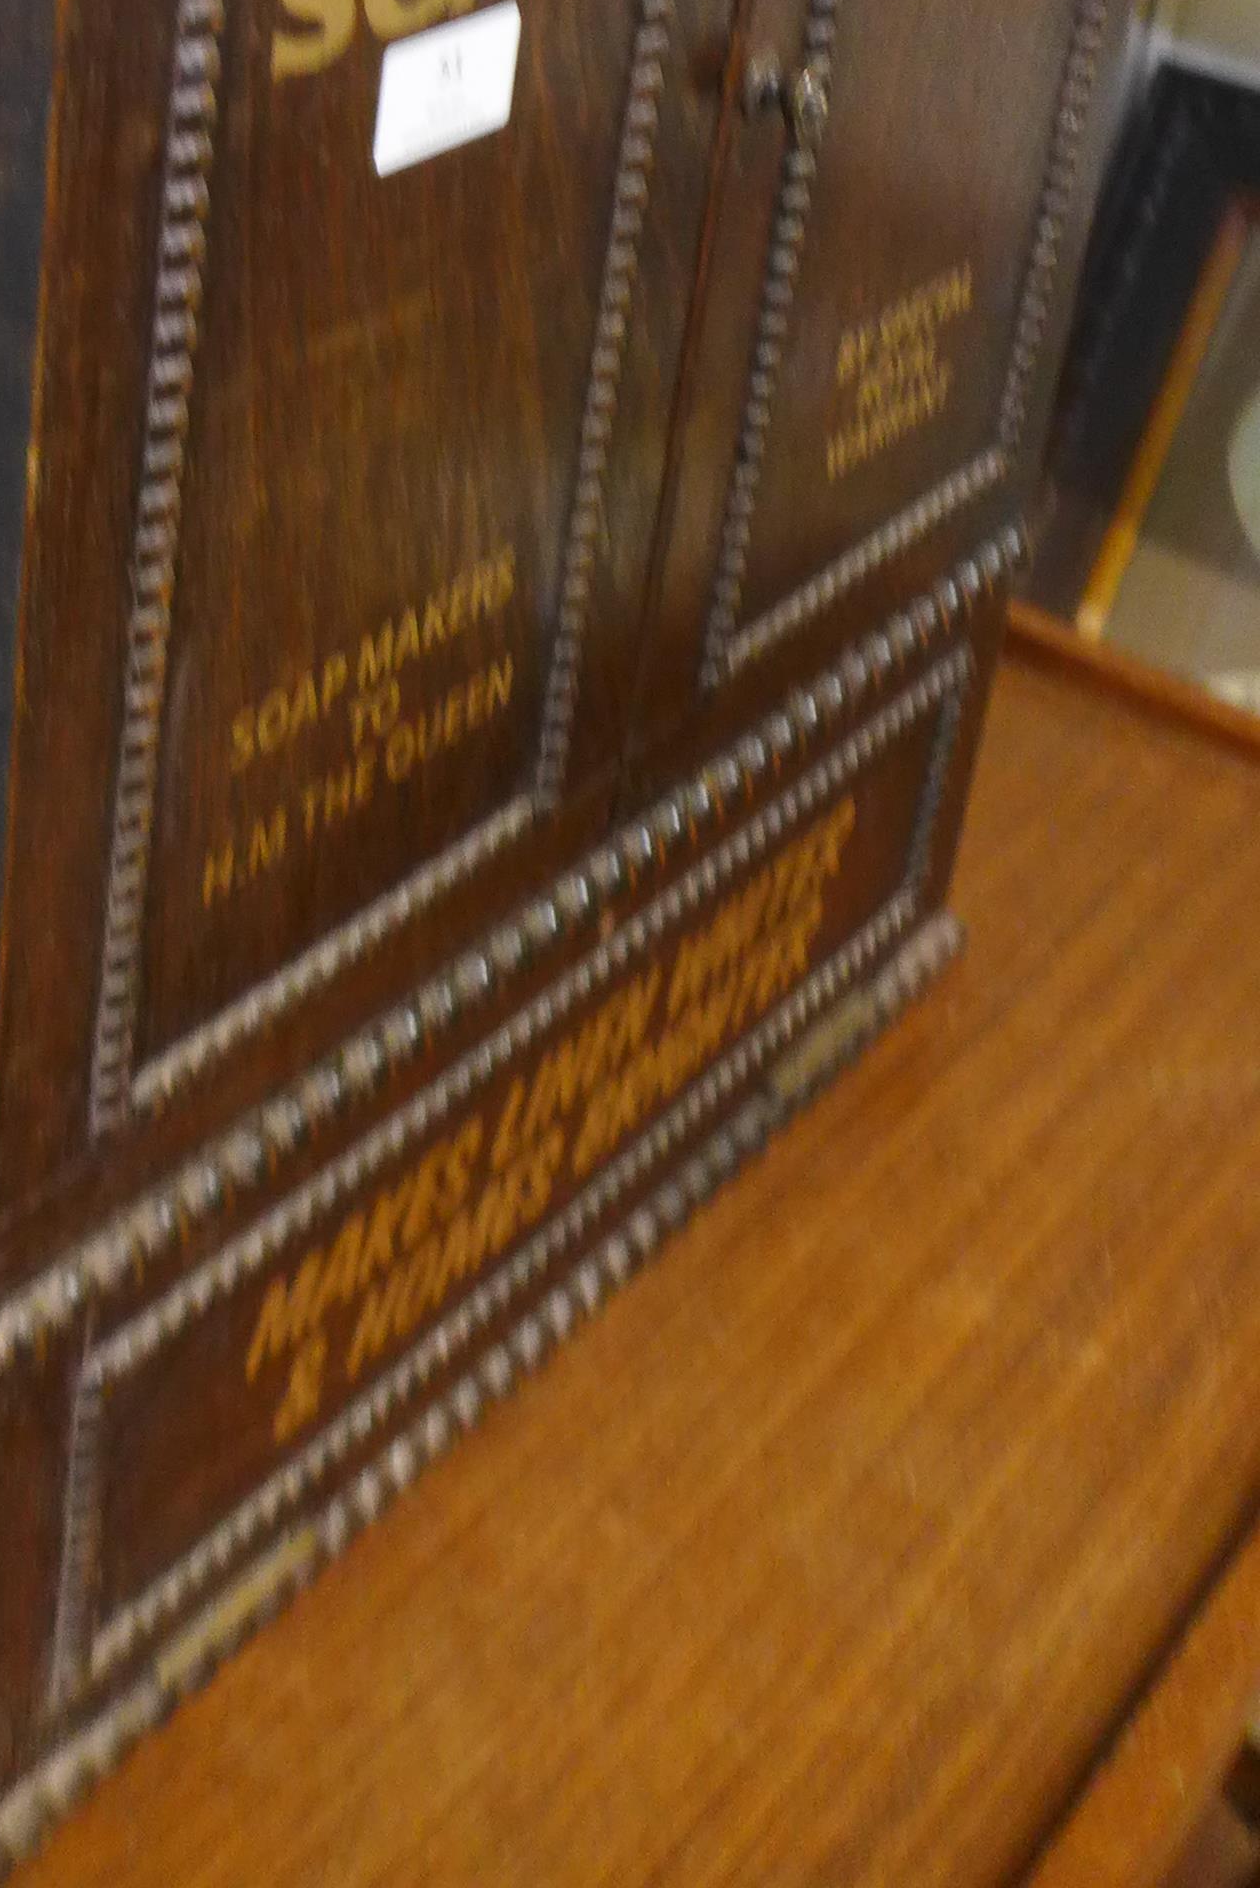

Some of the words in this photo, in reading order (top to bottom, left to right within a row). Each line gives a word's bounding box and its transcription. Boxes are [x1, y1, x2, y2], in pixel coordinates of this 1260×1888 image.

[232, 650, 348, 772] SOAP
[302, 744, 378, 840] THE
[385, 652, 514, 786] QUEEN
